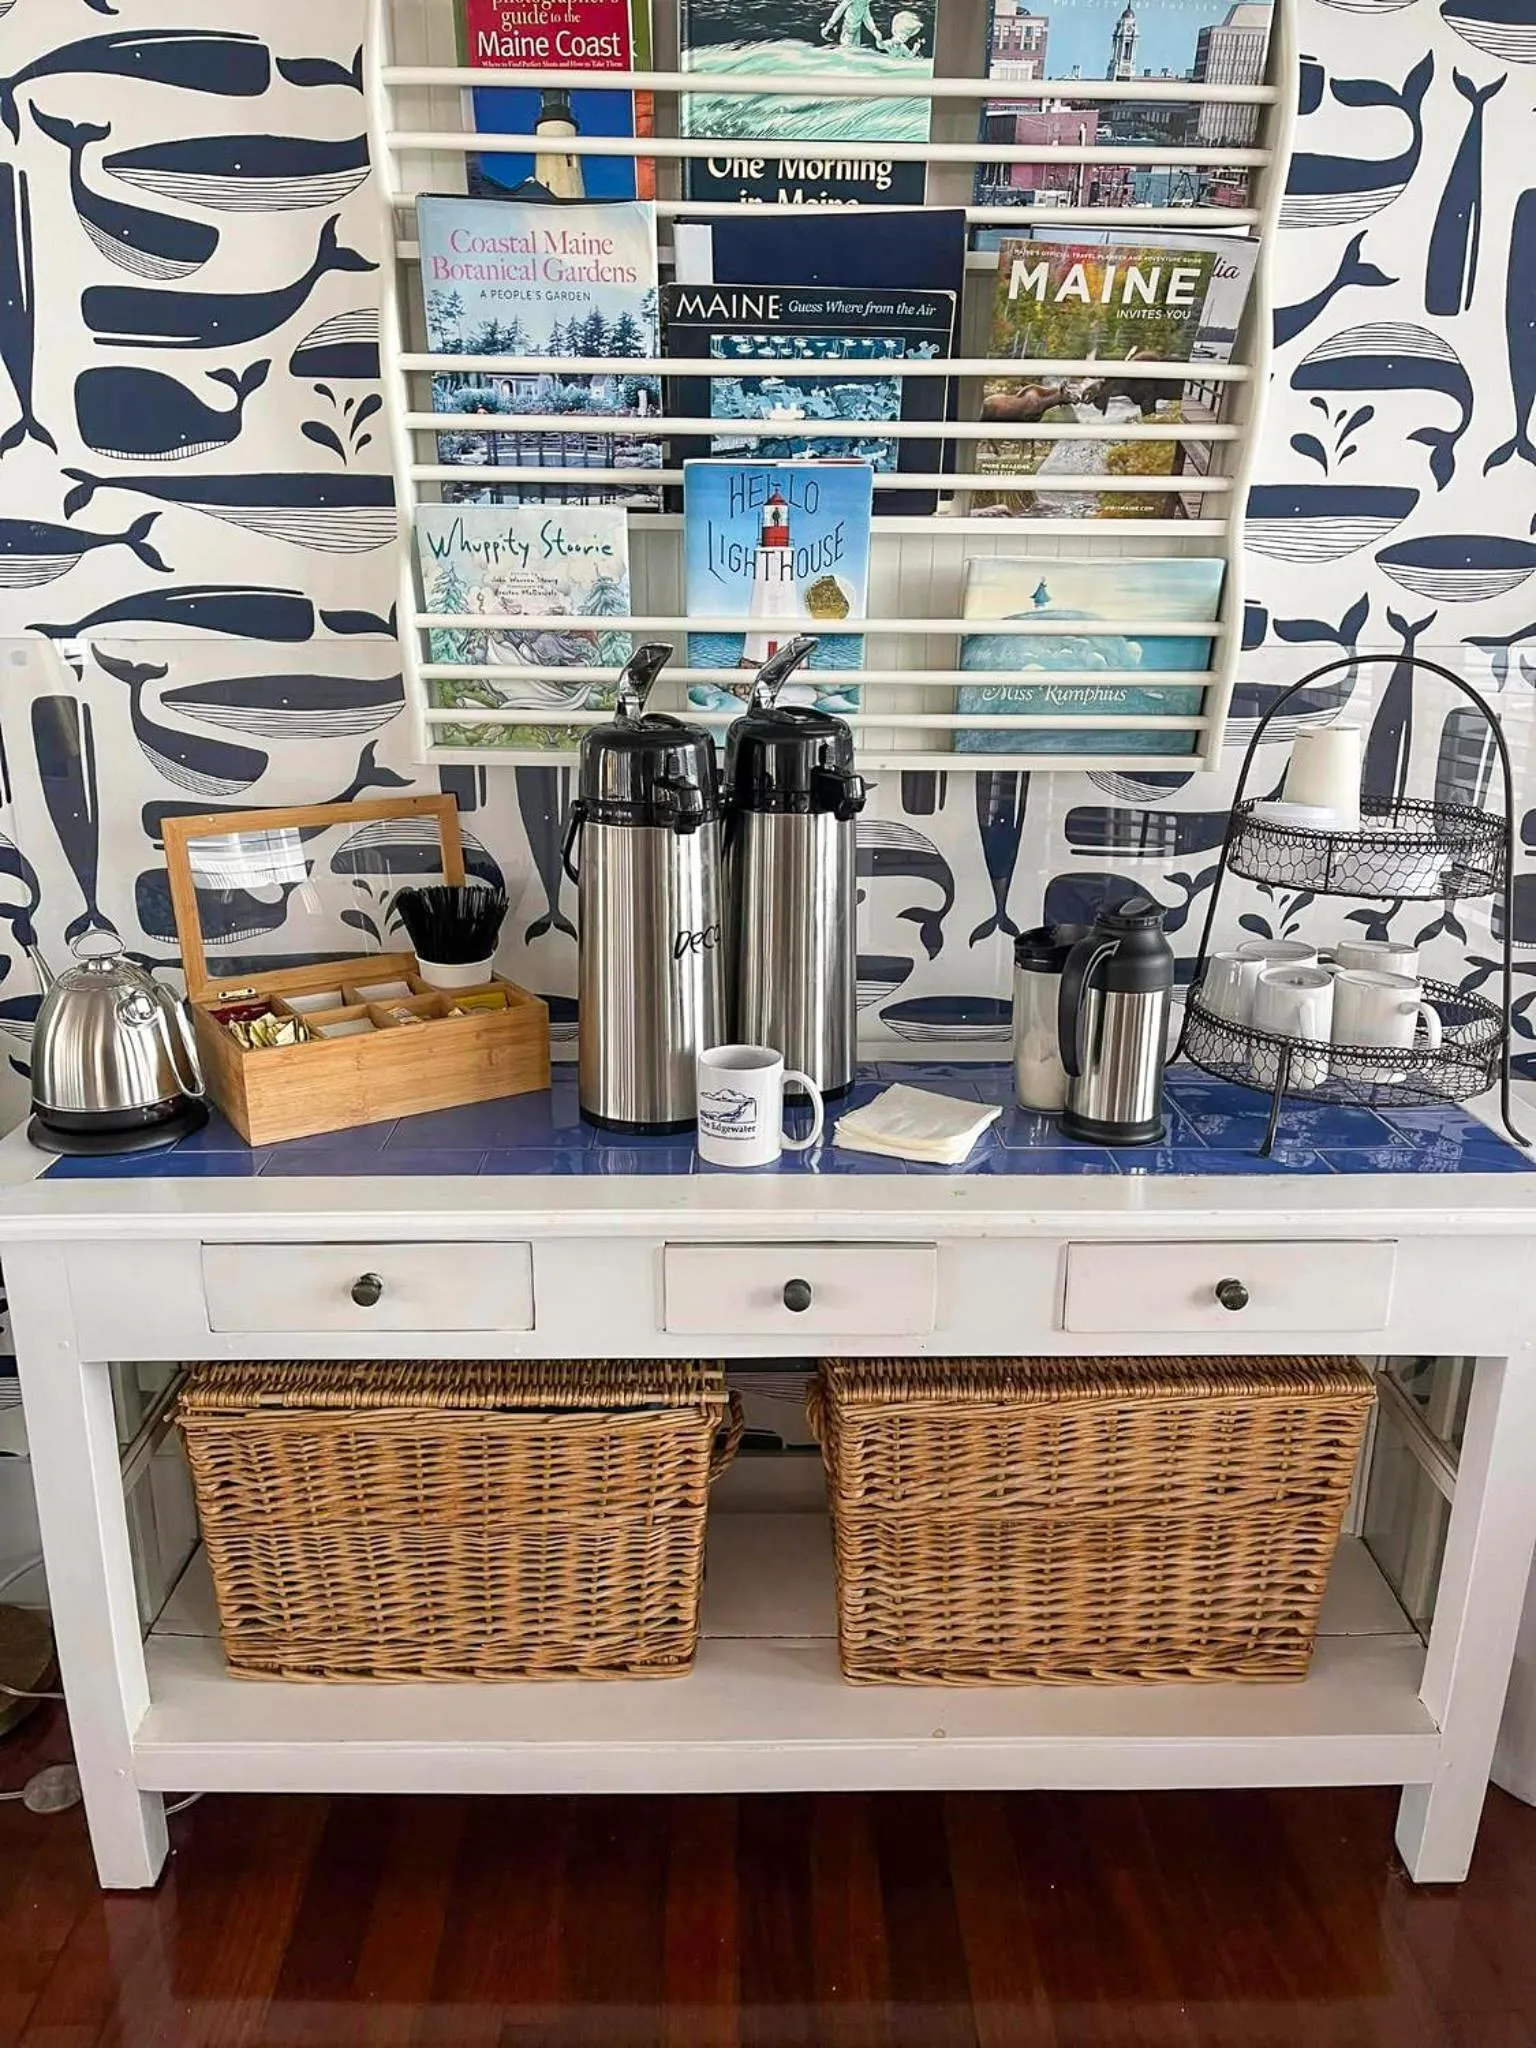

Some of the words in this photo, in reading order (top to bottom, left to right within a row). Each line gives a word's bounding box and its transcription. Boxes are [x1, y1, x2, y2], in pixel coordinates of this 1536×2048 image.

[501, 3, 548, 31] guide
[550, 13, 561, 23] to
[564, 9, 581, 23] the
[478, 31, 549, 57] Maine
[556, 31, 621, 57] Coast
[708, 158, 765, 179] One
[778, 159, 892, 190] Morning
[450, 229, 535, 254] Coastal
[544, 230, 613, 255] Maine
[432, 256, 535, 281] Botanical
[543, 258, 637, 283] Gardens
[1008, 260, 1201, 305] MAINE
[491, 290, 541, 300] PEOPLE'S
[546, 291, 591, 301] GARDEN
[676, 294, 783, 319] MAINE:
[788, 300, 822, 313] Guess
[826, 301, 865, 314] Where
[862, 301, 893, 316] from
[896, 302, 915, 315] the
[916, 303, 937, 316] Air
[1116, 310, 1161, 319] INVITES
[1165, 310, 1191, 320] YOU
[729, 472, 819, 518] HELLO
[427, 517, 529, 568] Whuppity
[541, 520, 613, 558] Stoorie
[708, 513, 845, 584] LIGHTHOUSE
[983, 685, 1033, 701] Miss
[1040, 685, 1127, 706] Rumphius
[711, 1121, 756, 1134] Edgewater
